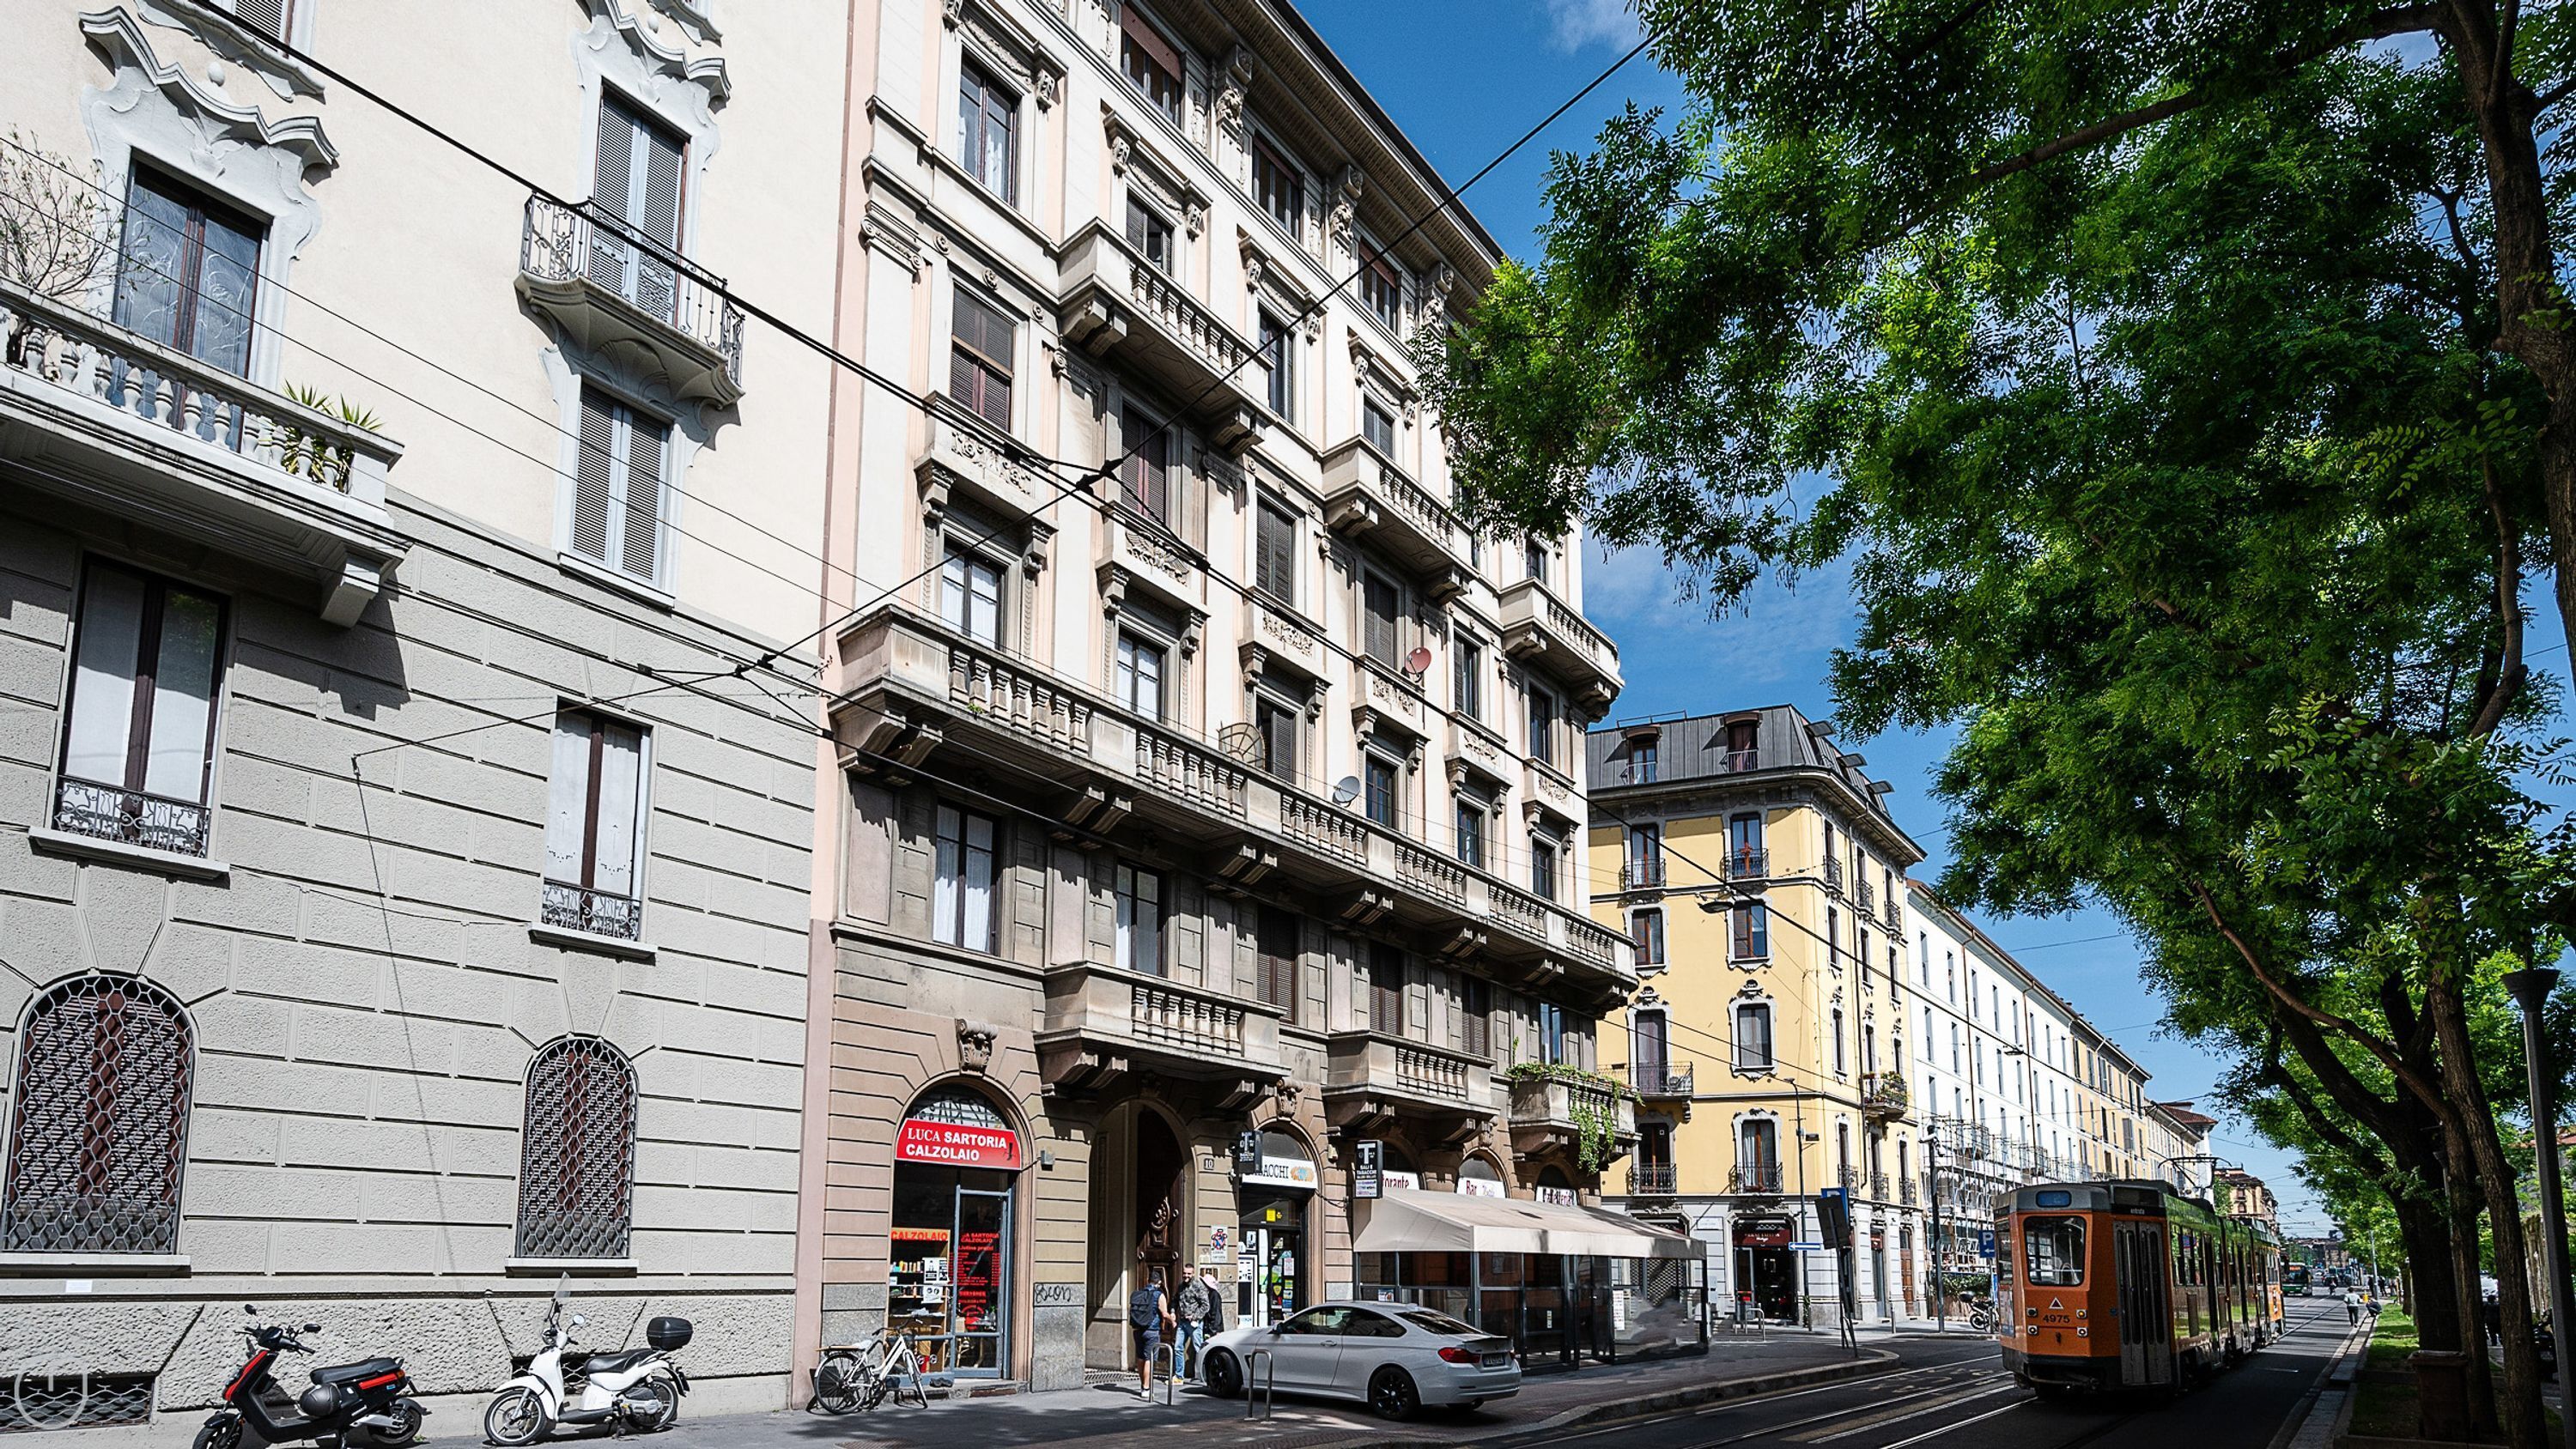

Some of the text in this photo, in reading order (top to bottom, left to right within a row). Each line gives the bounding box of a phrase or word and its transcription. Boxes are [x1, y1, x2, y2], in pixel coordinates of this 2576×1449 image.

[908, 1127, 1007, 1149] LUCA SARTORIA
[906, 1143, 981, 1161] CALZOLAIO
[1358, 1143, 1376, 1165] T
[1205, 1160, 1213, 1168] 10
[890, 1230, 948, 1241] CALZOLAIO
[1982, 1231, 1994, 1246] P
[2043, 1314, 2070, 1324] 4975
